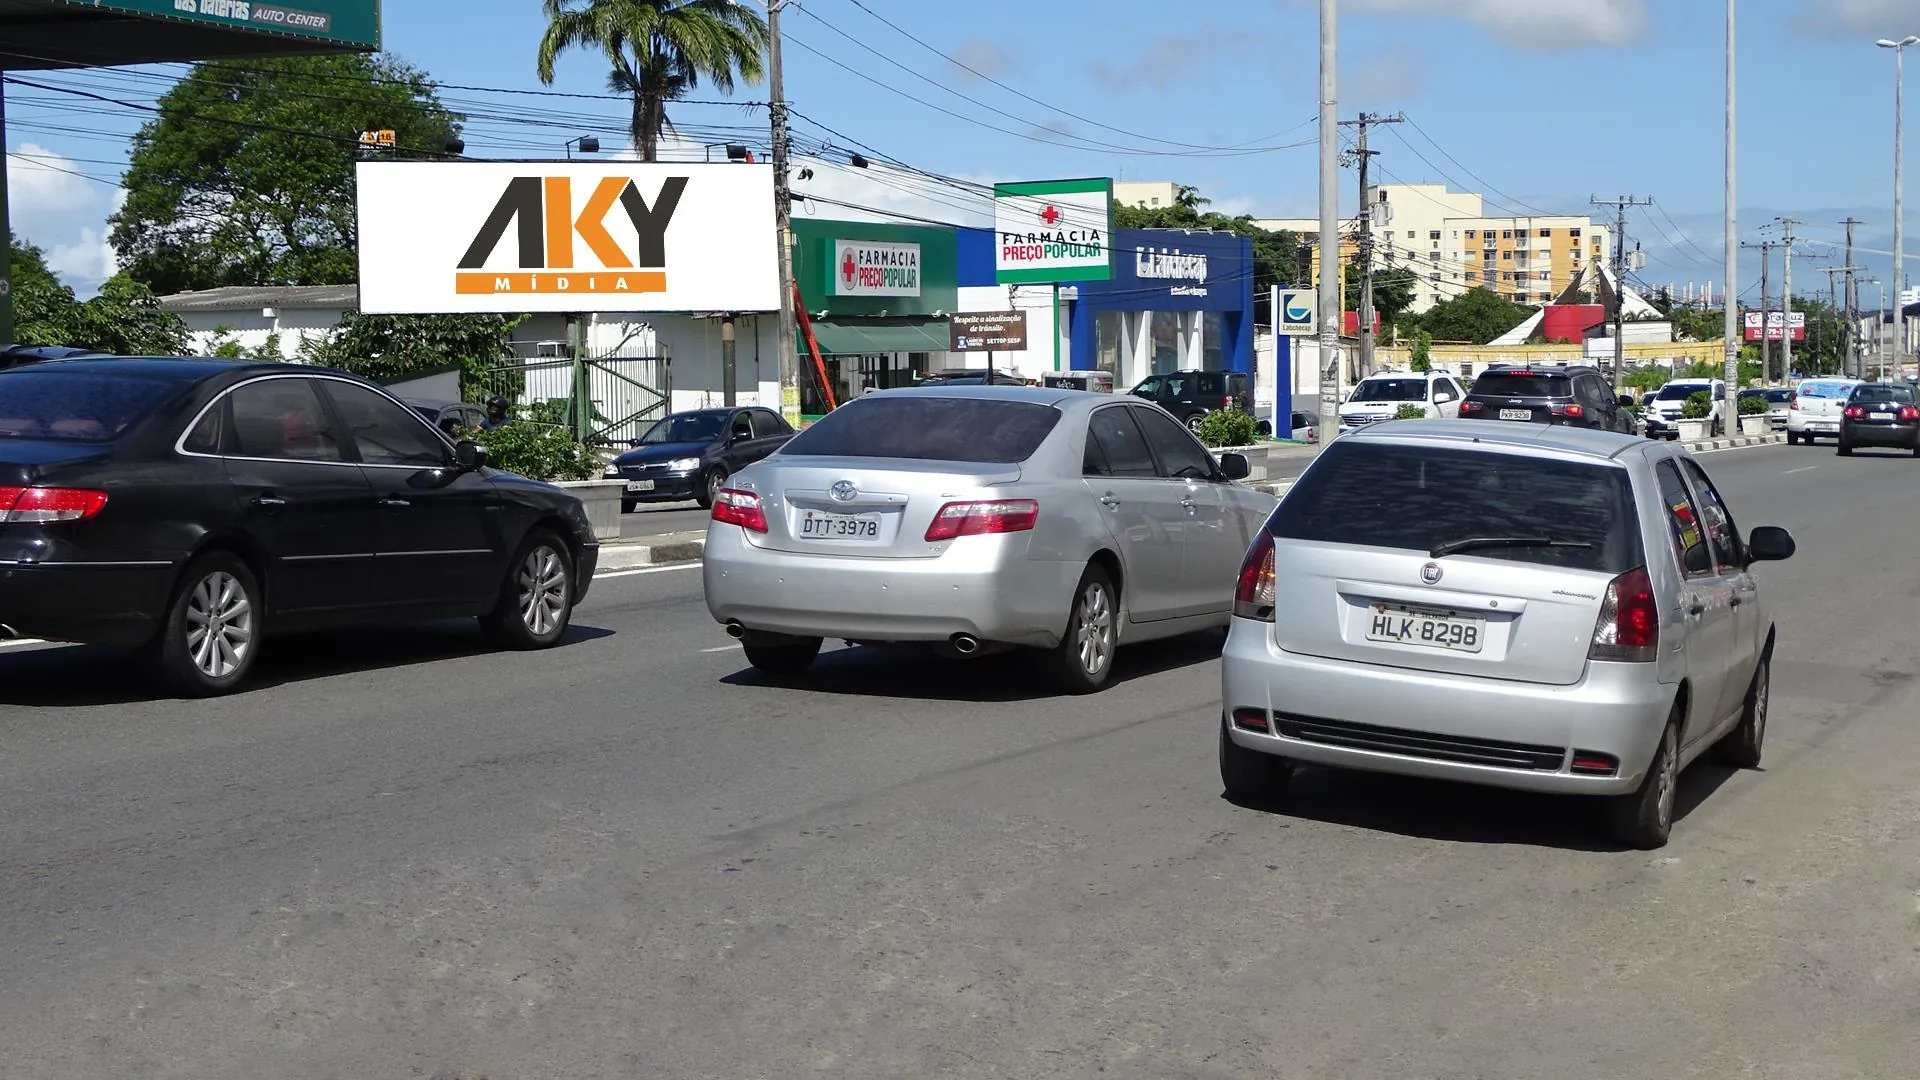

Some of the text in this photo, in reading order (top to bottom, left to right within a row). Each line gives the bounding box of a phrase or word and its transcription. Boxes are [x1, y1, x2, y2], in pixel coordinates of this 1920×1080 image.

[253, 4, 285, 22] AUTO
[286, 13, 327, 29] CENTER
[456, 176, 690, 269] AKY
[1002, 227, 1101, 245] FARMÁCIA
[859, 246, 917, 267] FARMÁCIA
[495, 273, 629, 291] MÍDIA
[953, 315, 979, 325] Respeite
[985, 313, 1022, 324] sinalização
[969, 325, 979, 333] de
